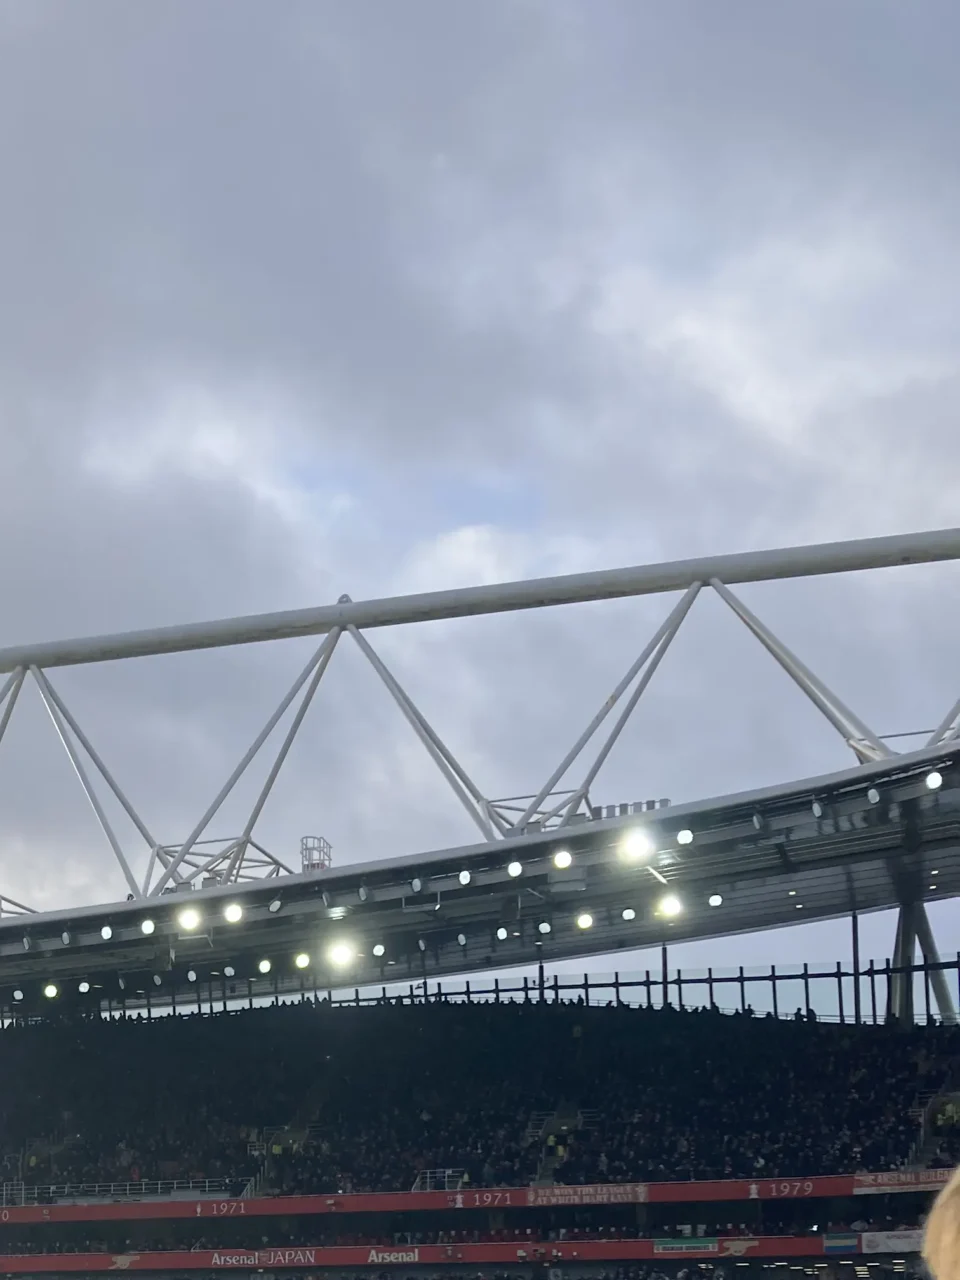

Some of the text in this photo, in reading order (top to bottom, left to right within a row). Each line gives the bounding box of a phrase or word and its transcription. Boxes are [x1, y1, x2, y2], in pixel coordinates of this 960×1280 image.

[770, 1182, 813, 1196] 1979
[474, 1193, 511, 1206] 1971
[211, 1203, 246, 1215] 1971
[212, 1250, 315, 1265] Arsenal JAPAN
[368, 1249, 418, 1263] Arsenal
